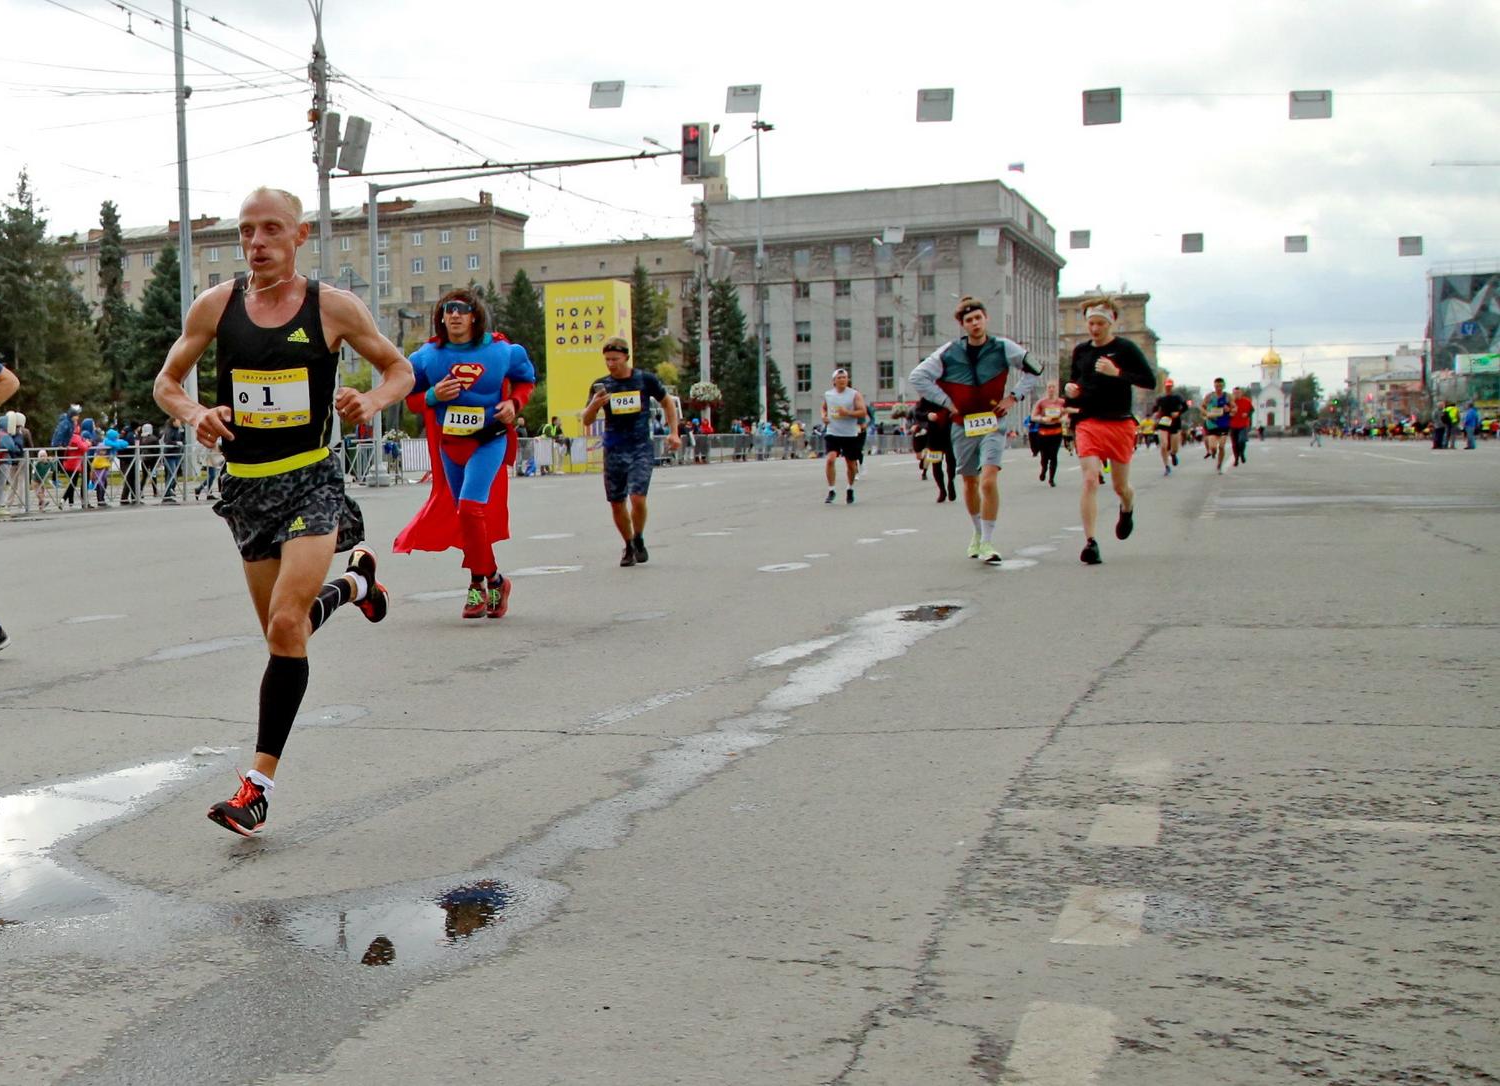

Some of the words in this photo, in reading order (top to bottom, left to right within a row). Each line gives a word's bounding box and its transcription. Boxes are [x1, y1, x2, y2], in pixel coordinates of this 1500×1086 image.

[556, 306, 604, 317] ПОЛУ
[556, 319, 605, 331] МАРА
[556, 335, 592, 345] ФОН
[262, 386, 274, 406] 1
[616, 397, 634, 406] 984
[449, 413, 478, 425] 1188
[969, 417, 992, 428] 1234
